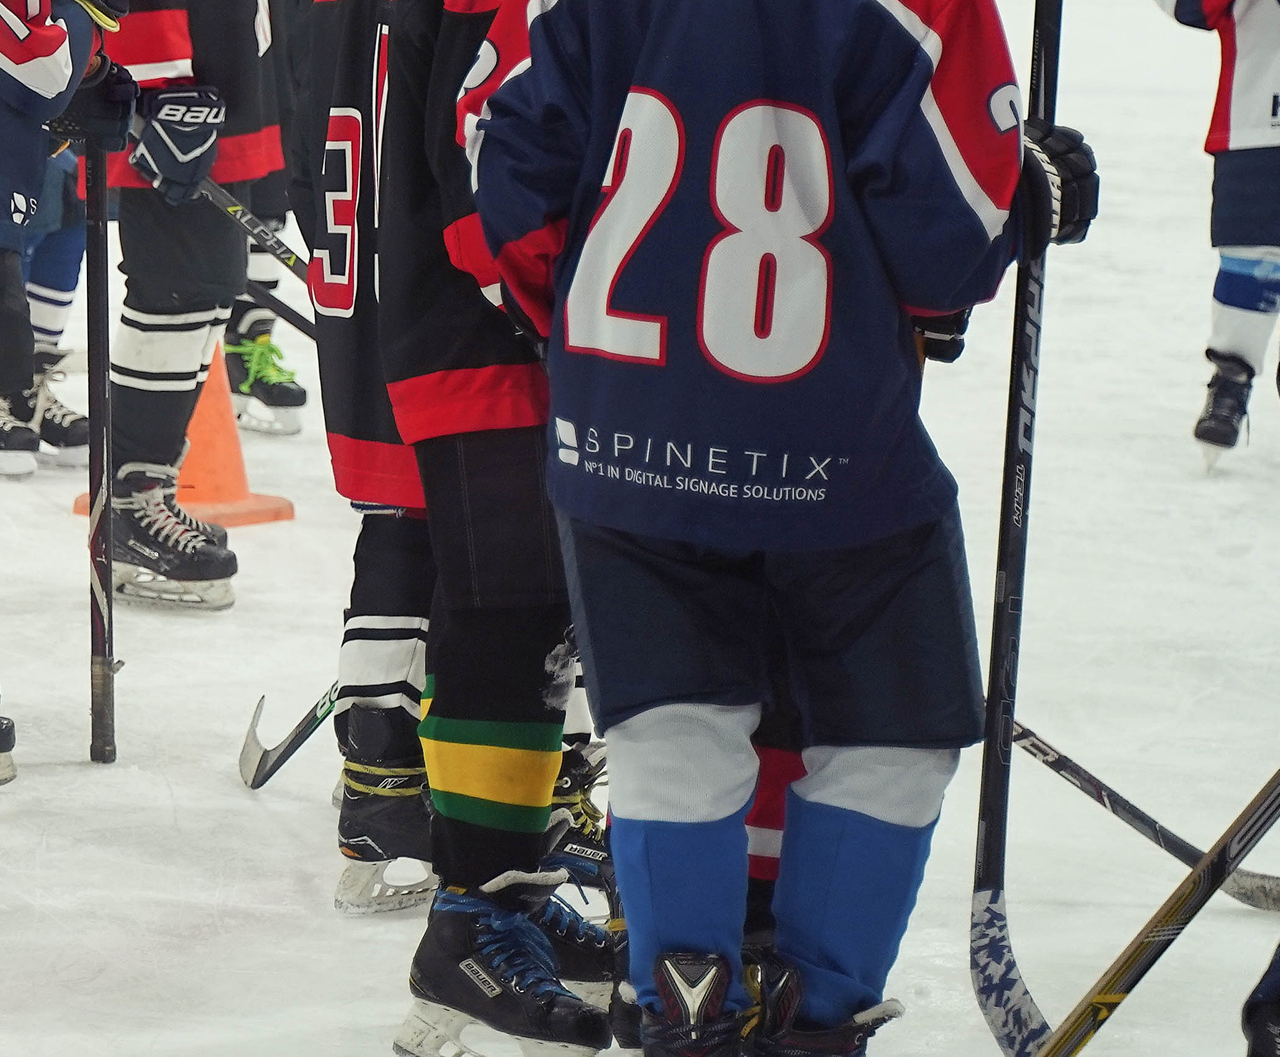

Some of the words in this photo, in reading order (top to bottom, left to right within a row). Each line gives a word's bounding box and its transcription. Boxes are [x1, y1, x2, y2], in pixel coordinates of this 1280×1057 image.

[226, 205, 297, 267] ALPHA
[564, 86, 835, 384] 28
[607, 465, 620, 480] IN
[625, 469, 673, 489] DIGITAL
[675, 475, 738, 498] SIGNAGE
[742, 484, 827, 501] SOLUTIONS
[568, 844, 607, 860] BAUER
[464, 962, 498, 994] BAUER
